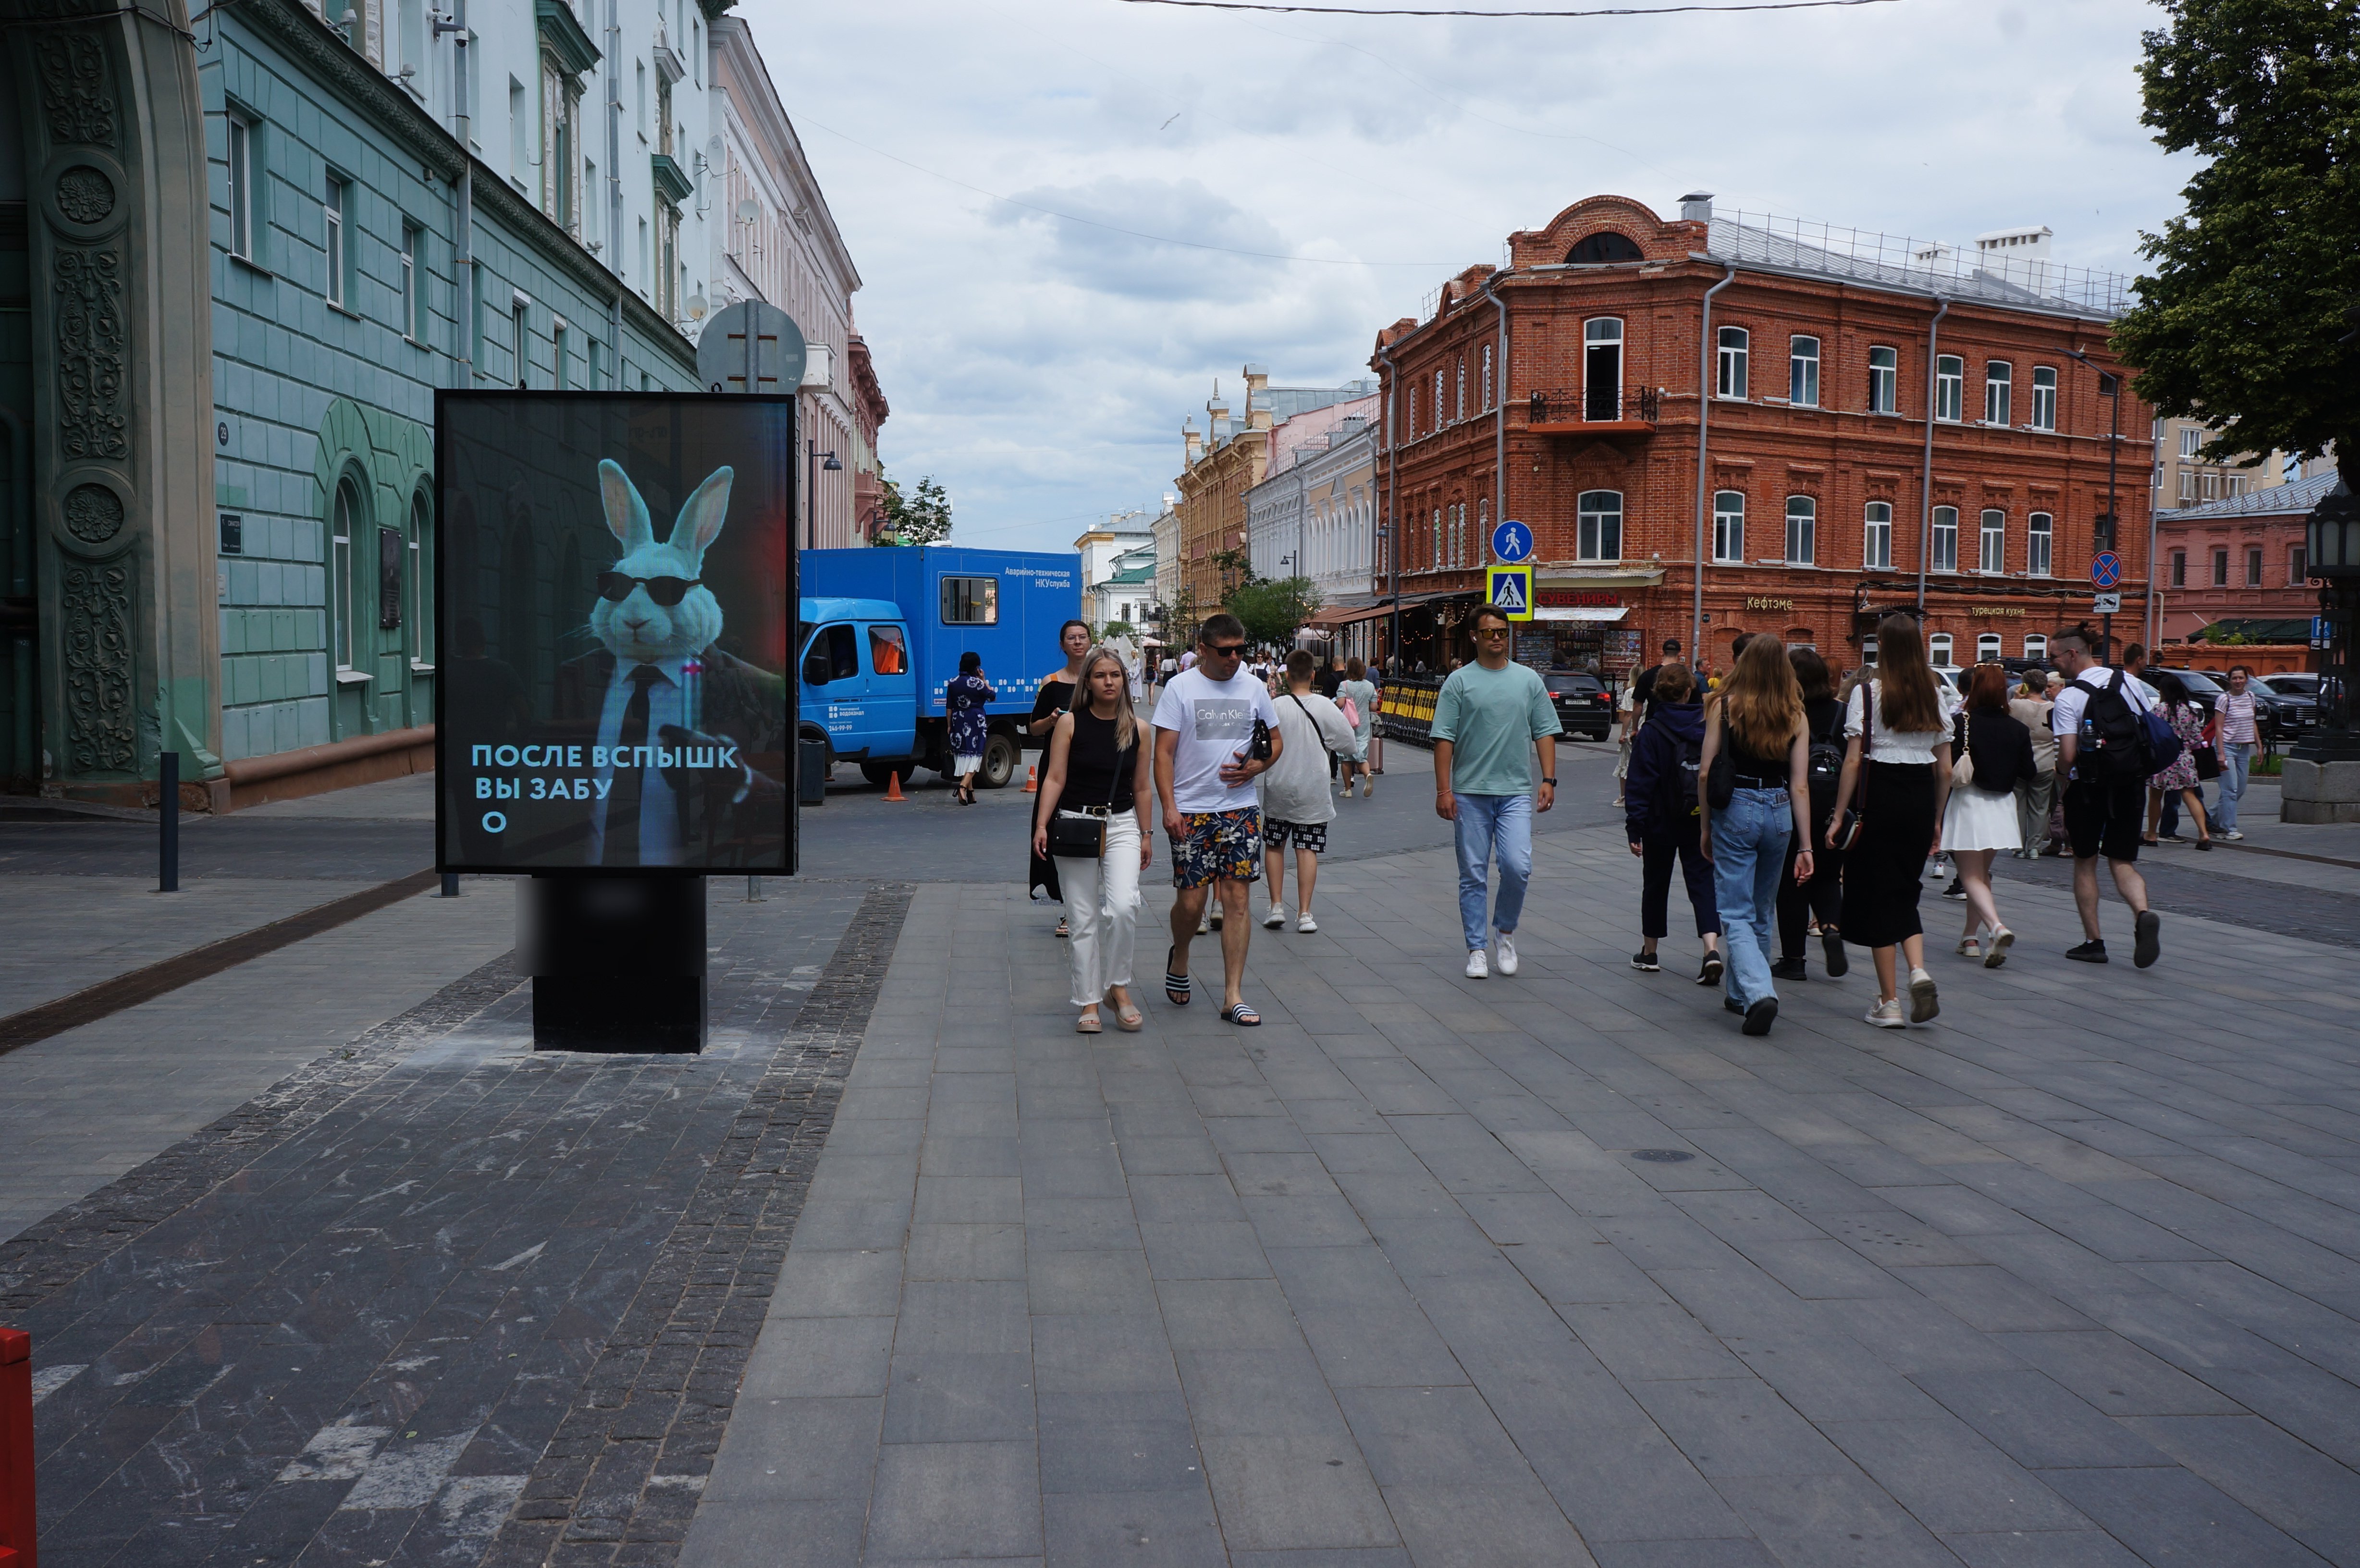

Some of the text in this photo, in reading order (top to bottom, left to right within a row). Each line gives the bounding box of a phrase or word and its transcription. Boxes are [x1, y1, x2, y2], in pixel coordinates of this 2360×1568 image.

[221, 427, 226, 439] 29
[1005, 567, 1070, 577] Аварийно-техническая
[1538, 593, 1618, 604] СУВЕНИРЫ
[1972, 607, 2025, 616] турецкая кухня
[1197, 709, 1227, 720] Calvin
[472, 745, 738, 768] ПОСЛЕ ВСПЫШК
[476, 777, 614, 800] ВЫ ЗАБУ
[482, 811, 507, 833] О
